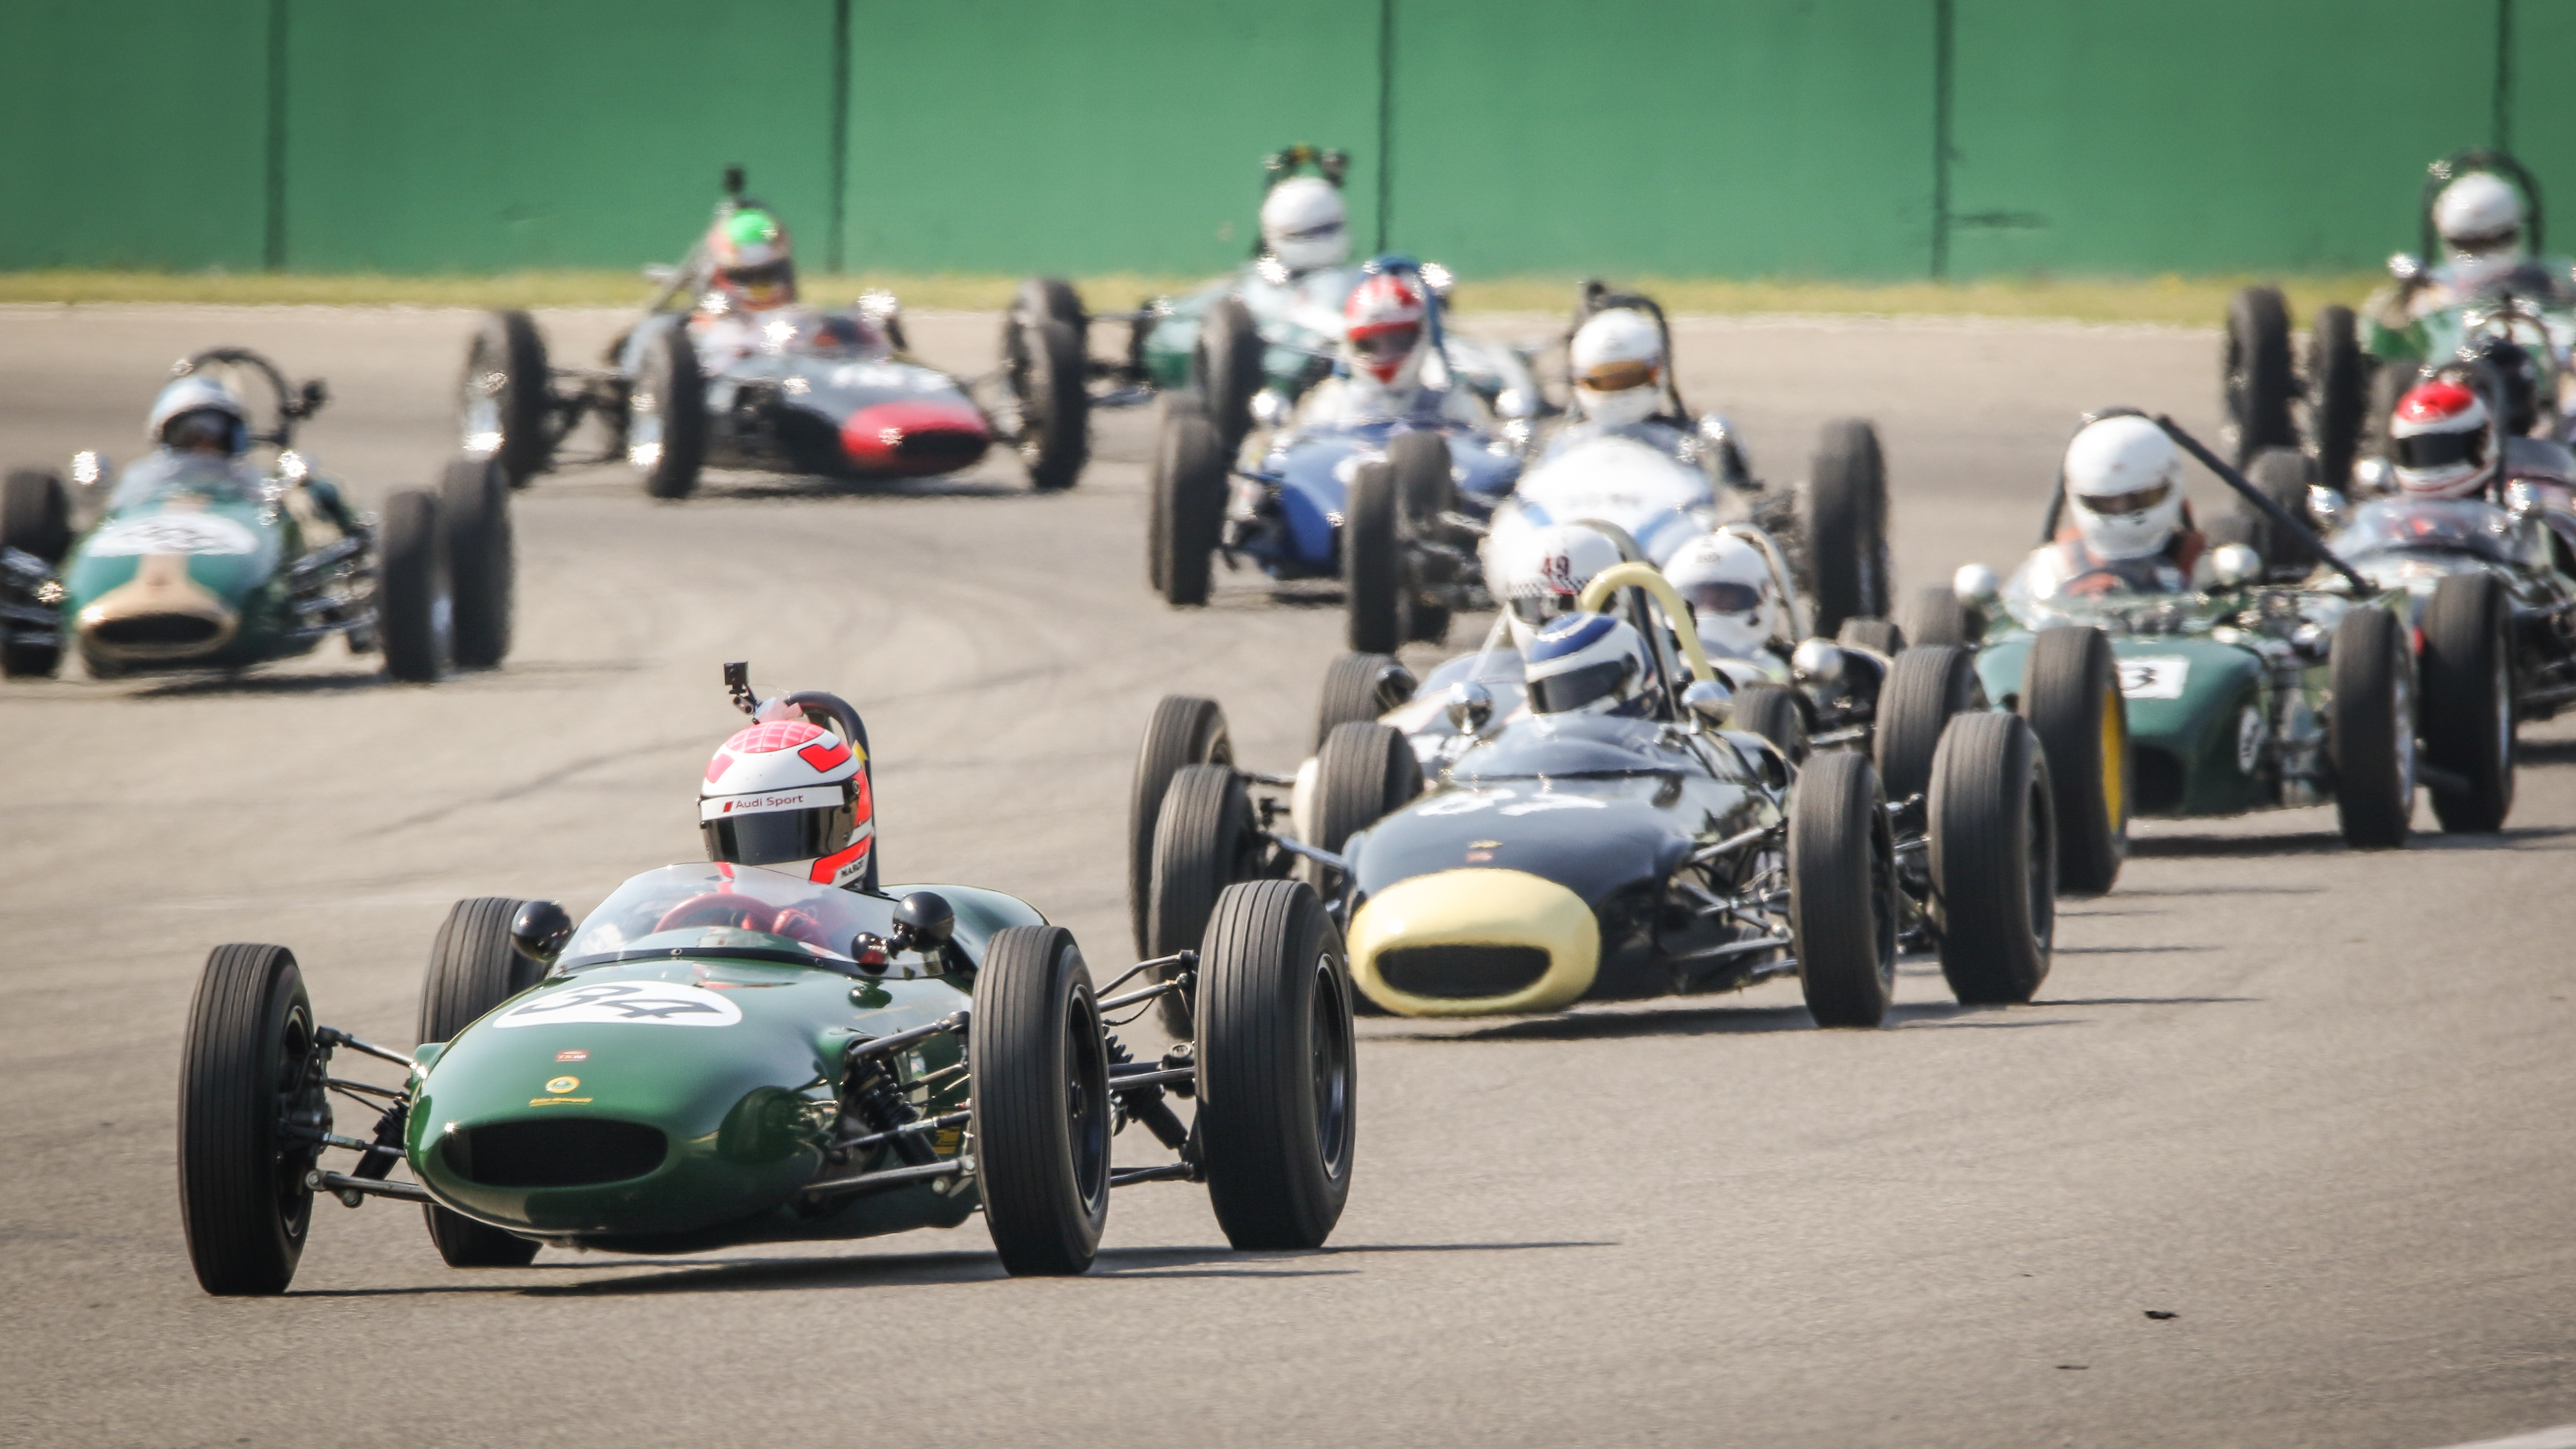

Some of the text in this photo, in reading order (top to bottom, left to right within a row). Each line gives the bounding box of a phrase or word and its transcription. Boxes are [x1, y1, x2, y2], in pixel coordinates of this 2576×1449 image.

[1541, 555, 1569, 577] 49
[735, 794, 804, 809] Audi Sport
[509, 985, 724, 1019] 34
